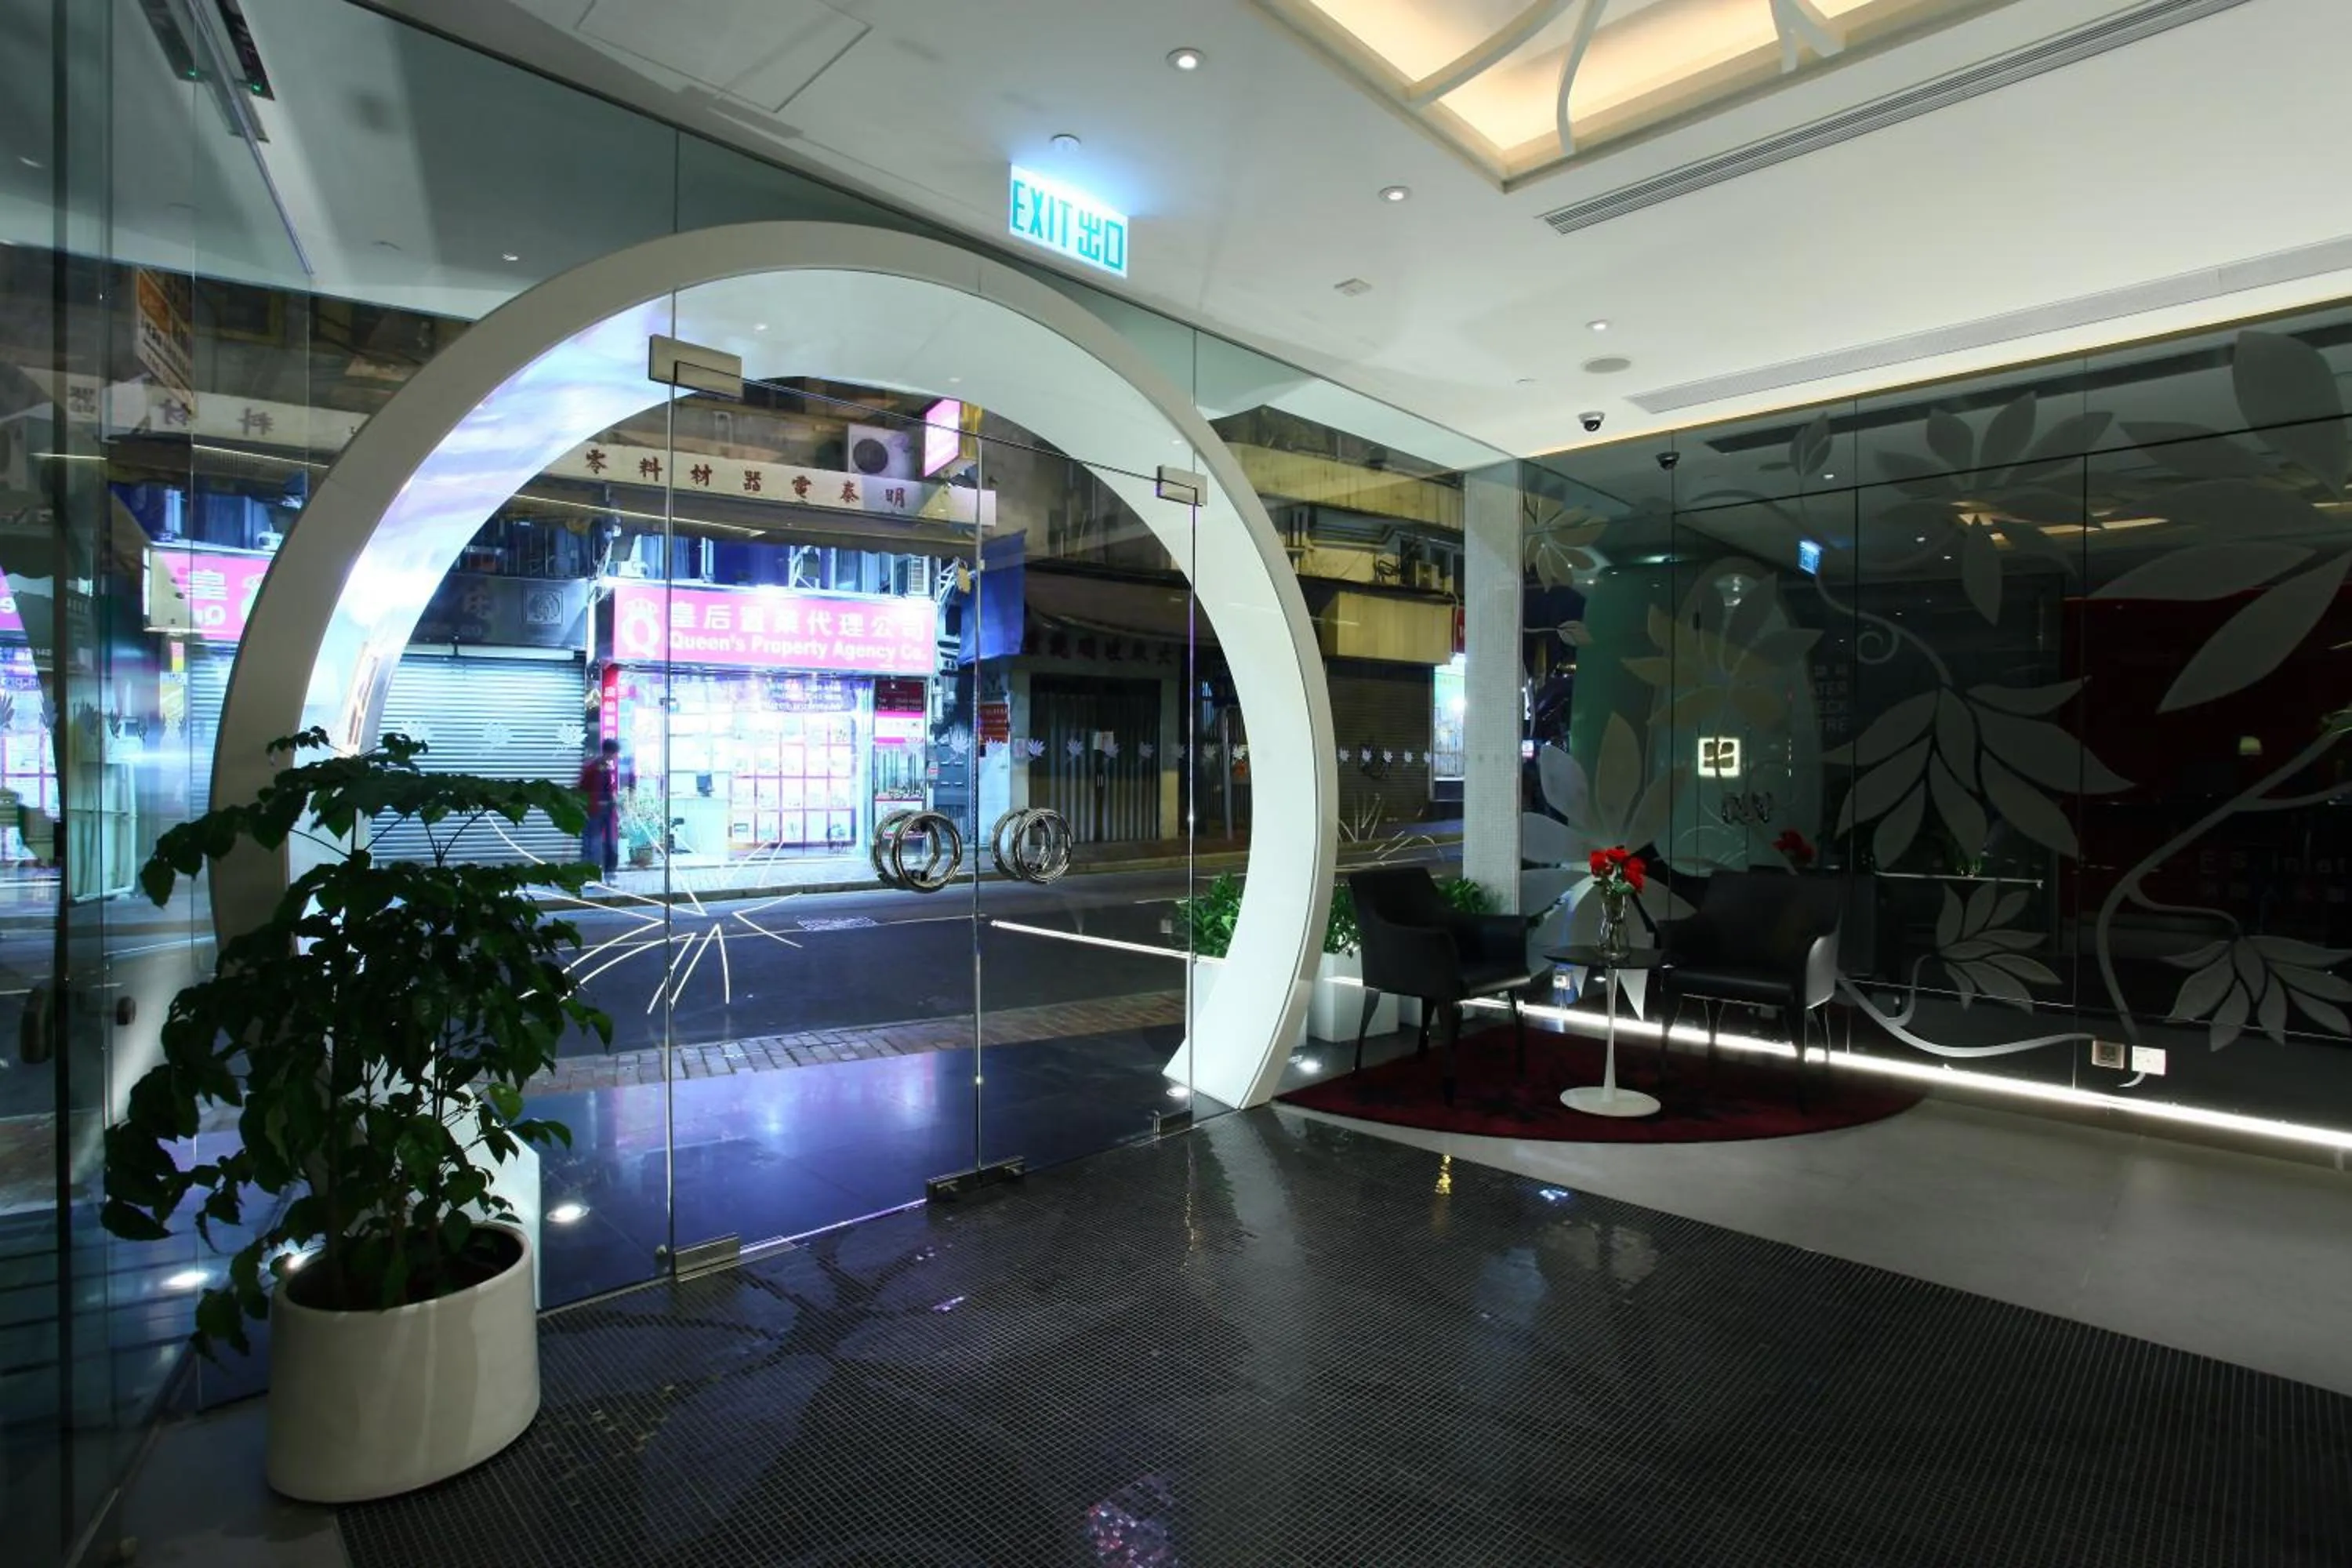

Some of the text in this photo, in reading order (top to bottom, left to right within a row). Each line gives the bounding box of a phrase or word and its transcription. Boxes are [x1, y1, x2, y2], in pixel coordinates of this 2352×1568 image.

[1012, 180, 1073, 248] EXIT
[1078, 209, 1123, 270] 出口
[670, 631, 746, 652] Queen's
[751, 635, 828, 659] Property
[833, 641, 897, 665] Agency
